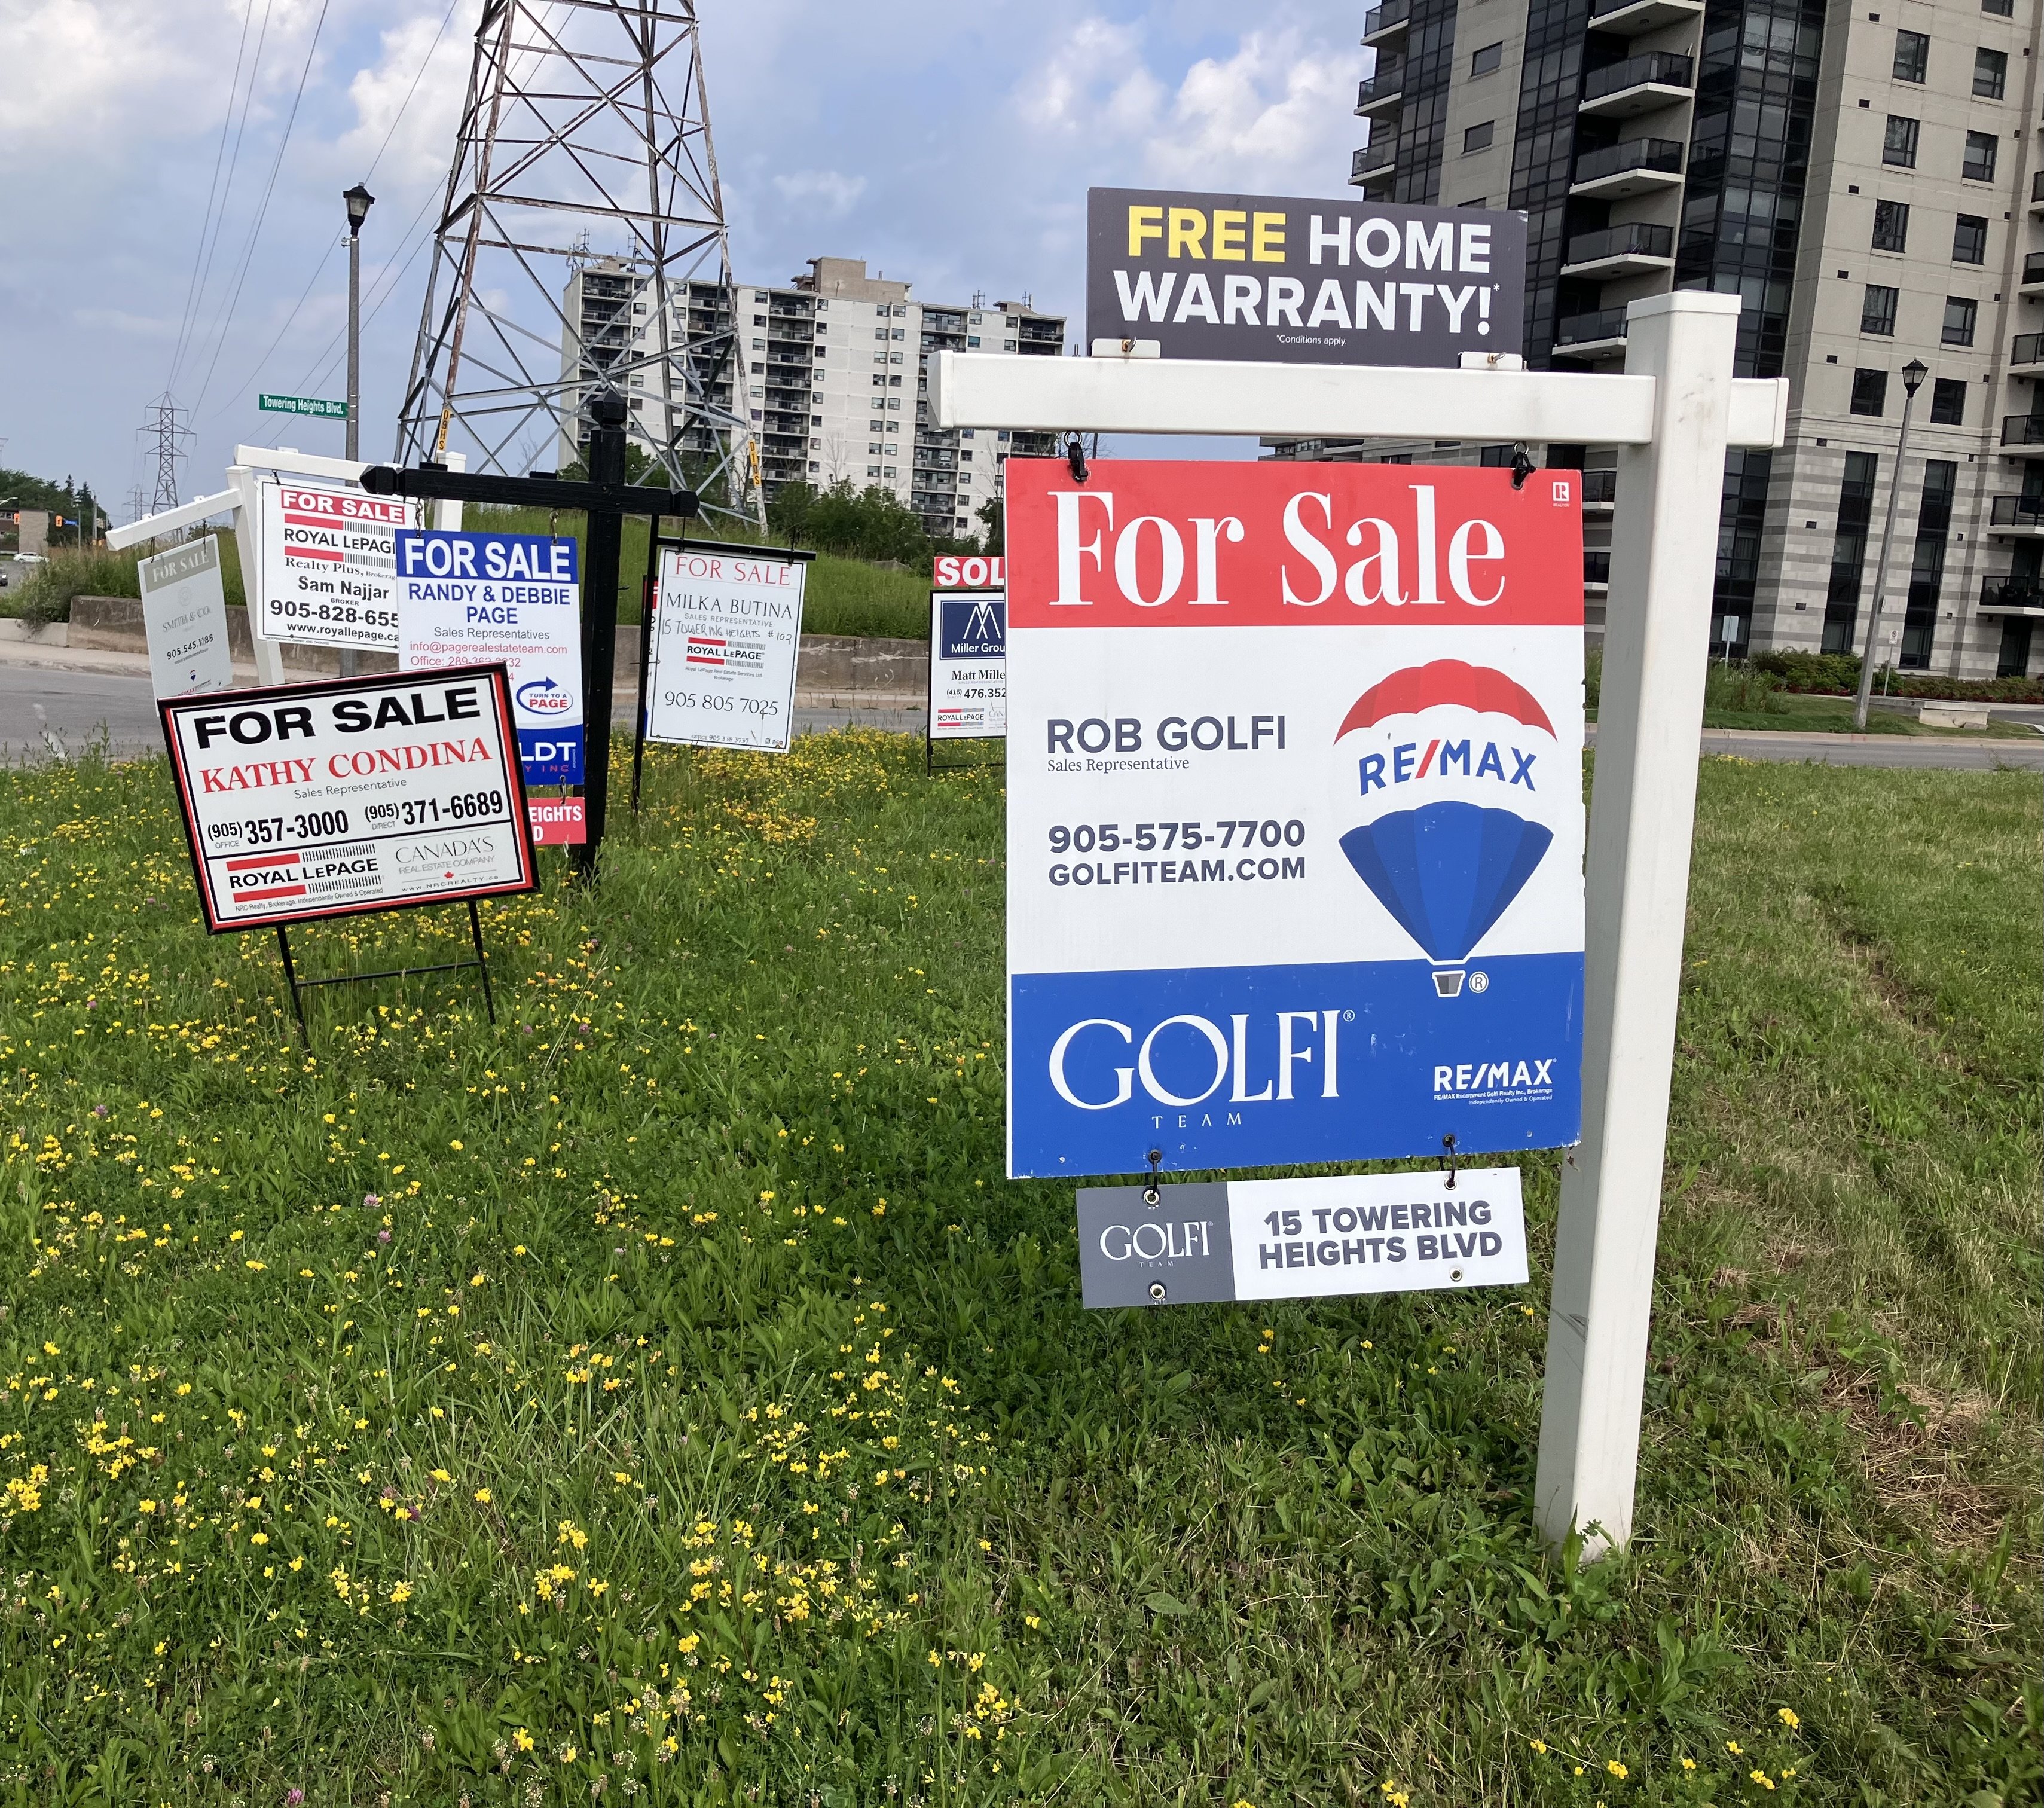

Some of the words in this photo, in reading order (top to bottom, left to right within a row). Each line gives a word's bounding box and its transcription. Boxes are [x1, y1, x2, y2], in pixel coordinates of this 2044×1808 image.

[1128, 205, 1287, 264] FREE
[1309, 214, 1492, 274] HOME
[1324, 337, 1347, 347] apply.
[263, 395, 296, 411] Towering
[298, 399, 325, 414] Heights
[326, 402, 344, 414] Blvd.
[283, 491, 334, 513] FOR
[341, 499, 404, 523] SALE
[284, 528, 338, 547] ROYAL
[344, 535, 395, 554] LEPAG
[1047, 490, 1245, 608] For
[1281, 484, 1507, 607] Sale
[152, 561, 178, 584] FOR
[179, 549, 209, 573] SALE
[285, 557, 329, 573] Realty
[333, 563, 363, 576] Plus,
[366, 570, 396, 581] Brokerag
[405, 538, 478, 577] FOR
[485, 542, 572, 581] SALE
[676, 556, 722, 579] FOR
[734, 561, 791, 586] SALE
[298, 575, 334, 593] Sam
[341, 581, 389, 601] Najjar
[408, 583, 477, 601] RANDY
[483, 585, 496, 603] &
[502, 586, 570, 605] DEBBIE
[466, 606, 518, 624] PAGE
[666, 593, 722, 613] MILKA
[730, 598, 792, 619] BUTINA
[163, 614, 188, 632] SMITH
[189, 612, 196, 621] &
[287, 623, 399, 641] www.royallepage.ca
[434, 627, 464, 638] Sales
[468, 627, 550, 640] Representatives
[661, 618, 671, 636] 15
[675, 621, 723, 637] TOWERING
[725, 628, 761, 639] HEIGHTS
[684, 613, 707, 622] SALES
[710, 615, 773, 628] REPRESENTATIVE
[410, 641, 567, 654] info@pagerealestateteam.com
[687, 645, 721, 657] ROYAL
[723, 648, 762, 661] LEPAGE
[951, 643, 979, 654] Miller
[981, 643, 1005, 653] Grou
[410, 656, 445, 667] Office:
[951, 670, 976, 680] Matt
[978, 669, 1006, 680] Mille
[529, 698, 568, 708] PAGE
[665, 691, 696, 708] 905
[702, 694, 734, 711] 805
[740, 698, 779, 716] 7025
[194, 706, 316, 749] FOR
[332, 686, 481, 733] SALE
[1047, 718, 1142, 753] ROB
[1157, 715, 1285, 752] GOLFI
[199, 757, 317, 793] KATHY
[328, 737, 493, 778] CONDINA
[1047, 759, 1082, 772] Sales
[1086, 756, 1190, 774] Representative
[1358, 738, 1537, 796] RE/MAX
[294, 787, 323, 799] Sales
[326, 778, 407, 797] Representative
[207, 821, 243, 841] (905)
[245, 810, 349, 845] 357-3000
[365, 802, 399, 823] (905)
[401, 790, 503, 825] 371-6689
[215, 840, 240, 849] OFFICE
[371, 821, 396, 830] DIRECT
[1049, 819, 1306, 854] 905-575-7700
[395, 836, 494, 863] CANADA'S
[229, 869, 299, 888] ROYAL
[303, 858, 378, 880] LEPAGE
[399, 865, 421, 874] REAL
[422, 860, 451, 872] ESTATE
[453, 855, 495, 868] COMPANY
[1049, 857, 1306, 887] GOLFITEAM.COM
[298, 894, 334, 905] Independently
[359, 887, 383, 897] Operated
[1434, 1059, 1553, 1091] RE/MAX
[1151, 1112, 1242, 1129] TEAM
[1264, 1210, 1302, 1236] 15
[1312, 1200, 1492, 1233] TOWERING
[1099, 1221, 1210, 1260] GOLFI
[1259, 1236, 1407, 1269] HEIGHTS
[1417, 1231, 1502, 1260] BLVD
